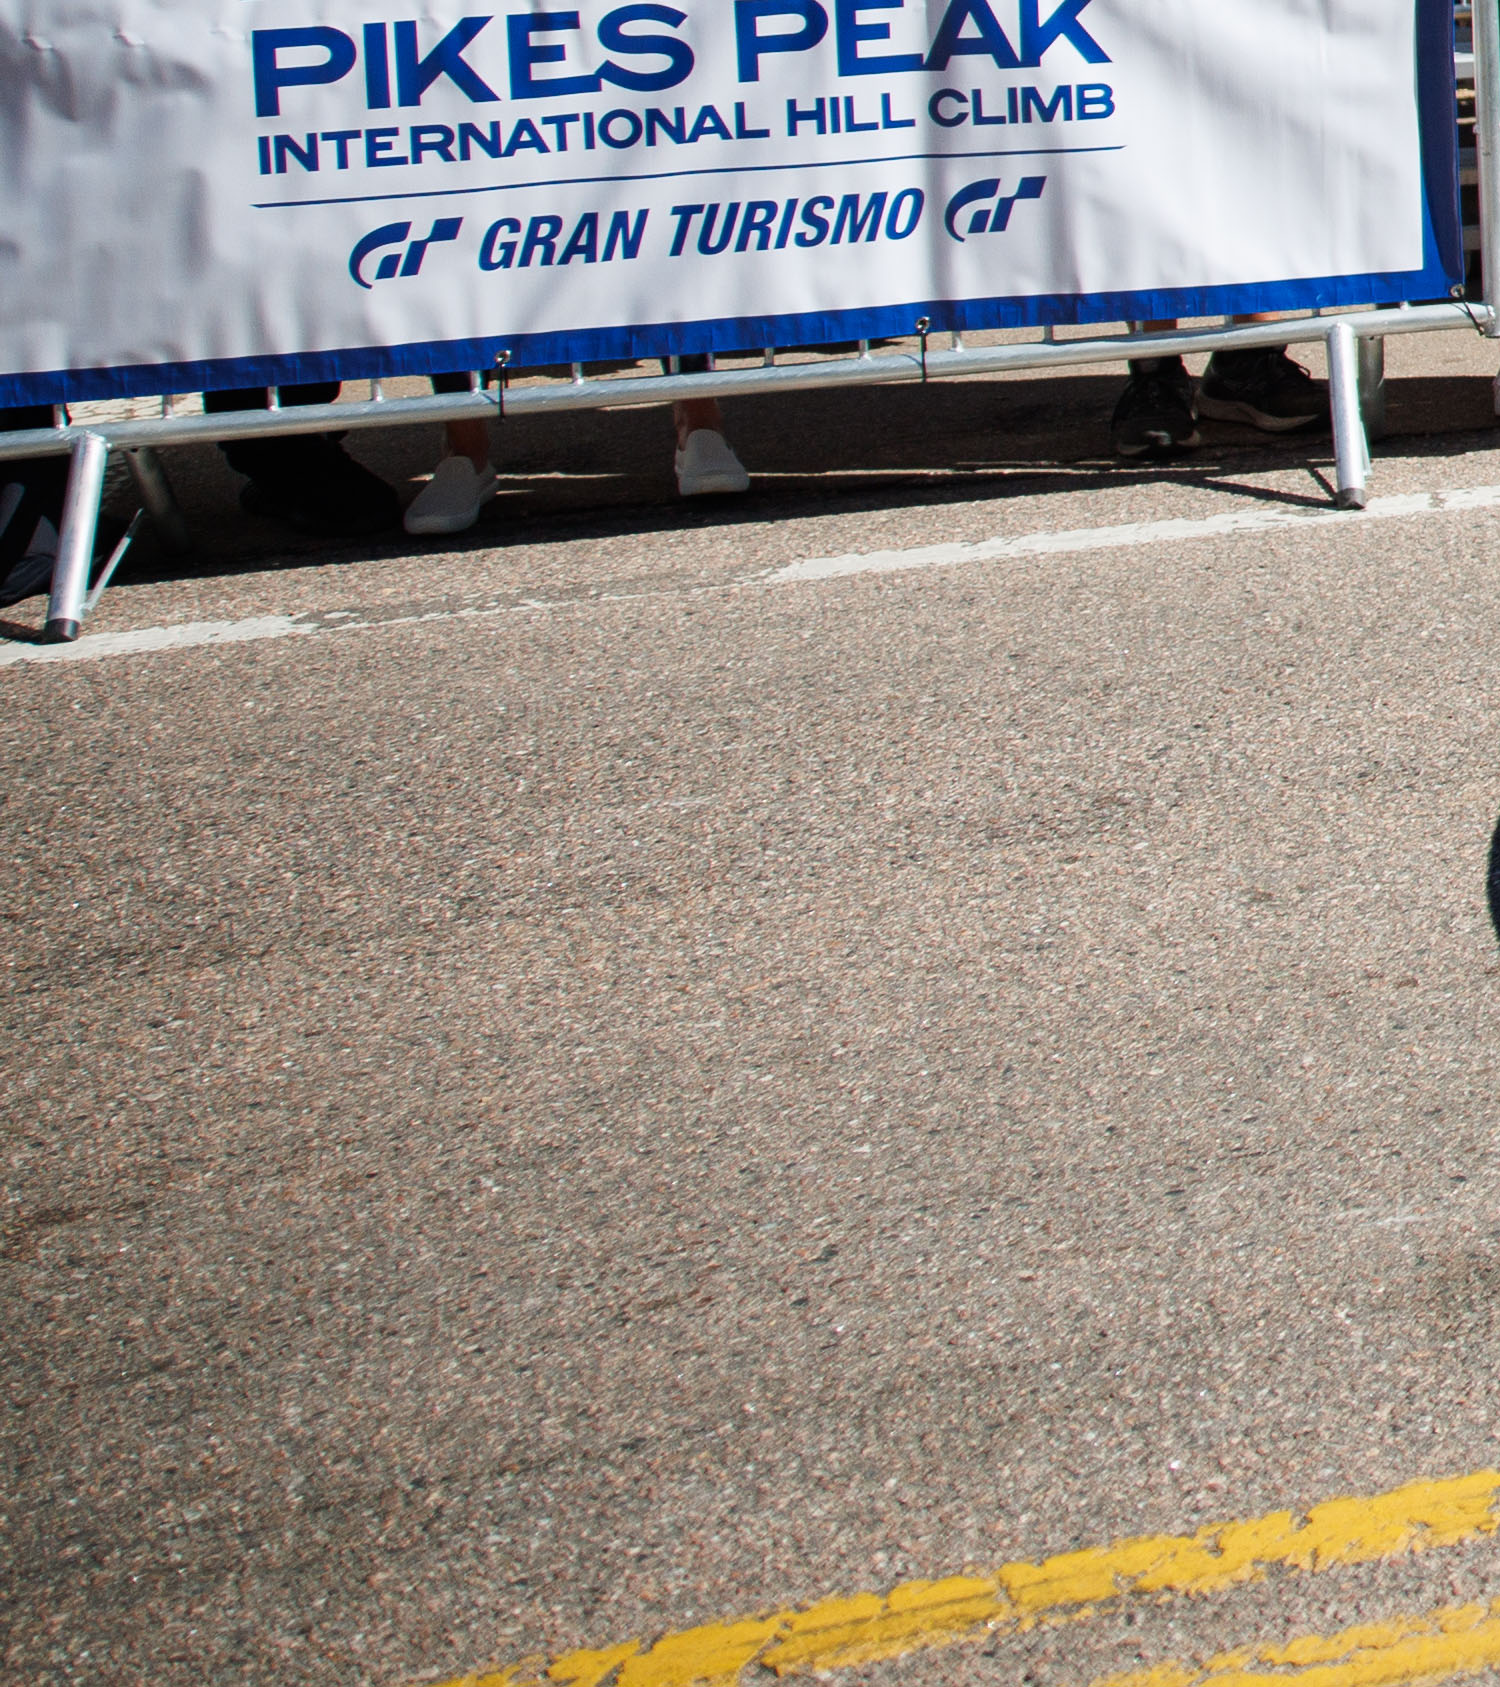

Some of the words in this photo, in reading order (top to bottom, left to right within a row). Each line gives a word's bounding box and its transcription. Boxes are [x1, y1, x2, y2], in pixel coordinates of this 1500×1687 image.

[251, 3, 696, 118] PIKES
[258, 102, 769, 176] INTERNATIONAL
[786, 93, 914, 138] HILL
[928, 83, 1115, 128] CLIMB
[478, 207, 650, 273] GRAN
[668, 186, 925, 259] TURISMO
